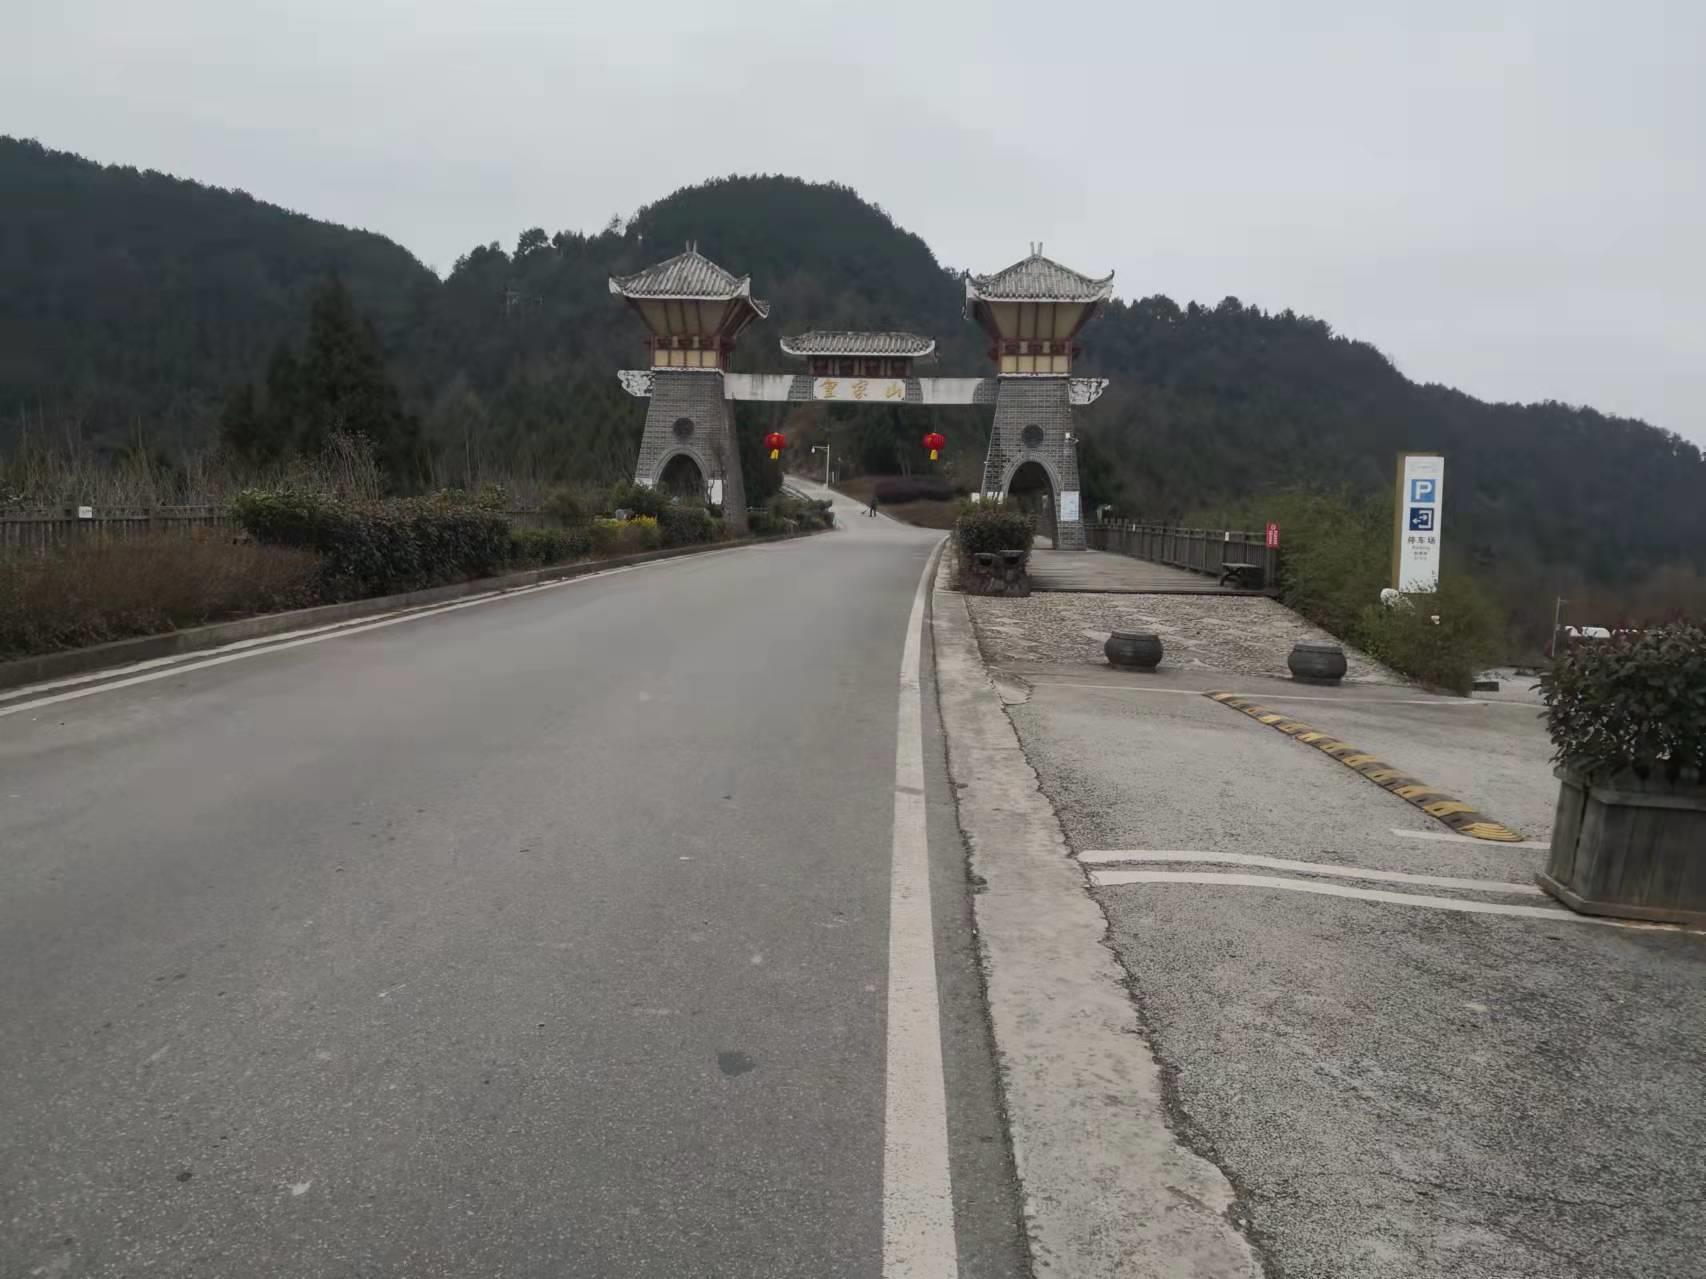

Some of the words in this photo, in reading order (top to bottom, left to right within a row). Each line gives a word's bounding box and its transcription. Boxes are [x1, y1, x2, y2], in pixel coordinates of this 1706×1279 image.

[1415, 481, 1433, 500] P
[1407, 536, 1436, 545] 停车场
